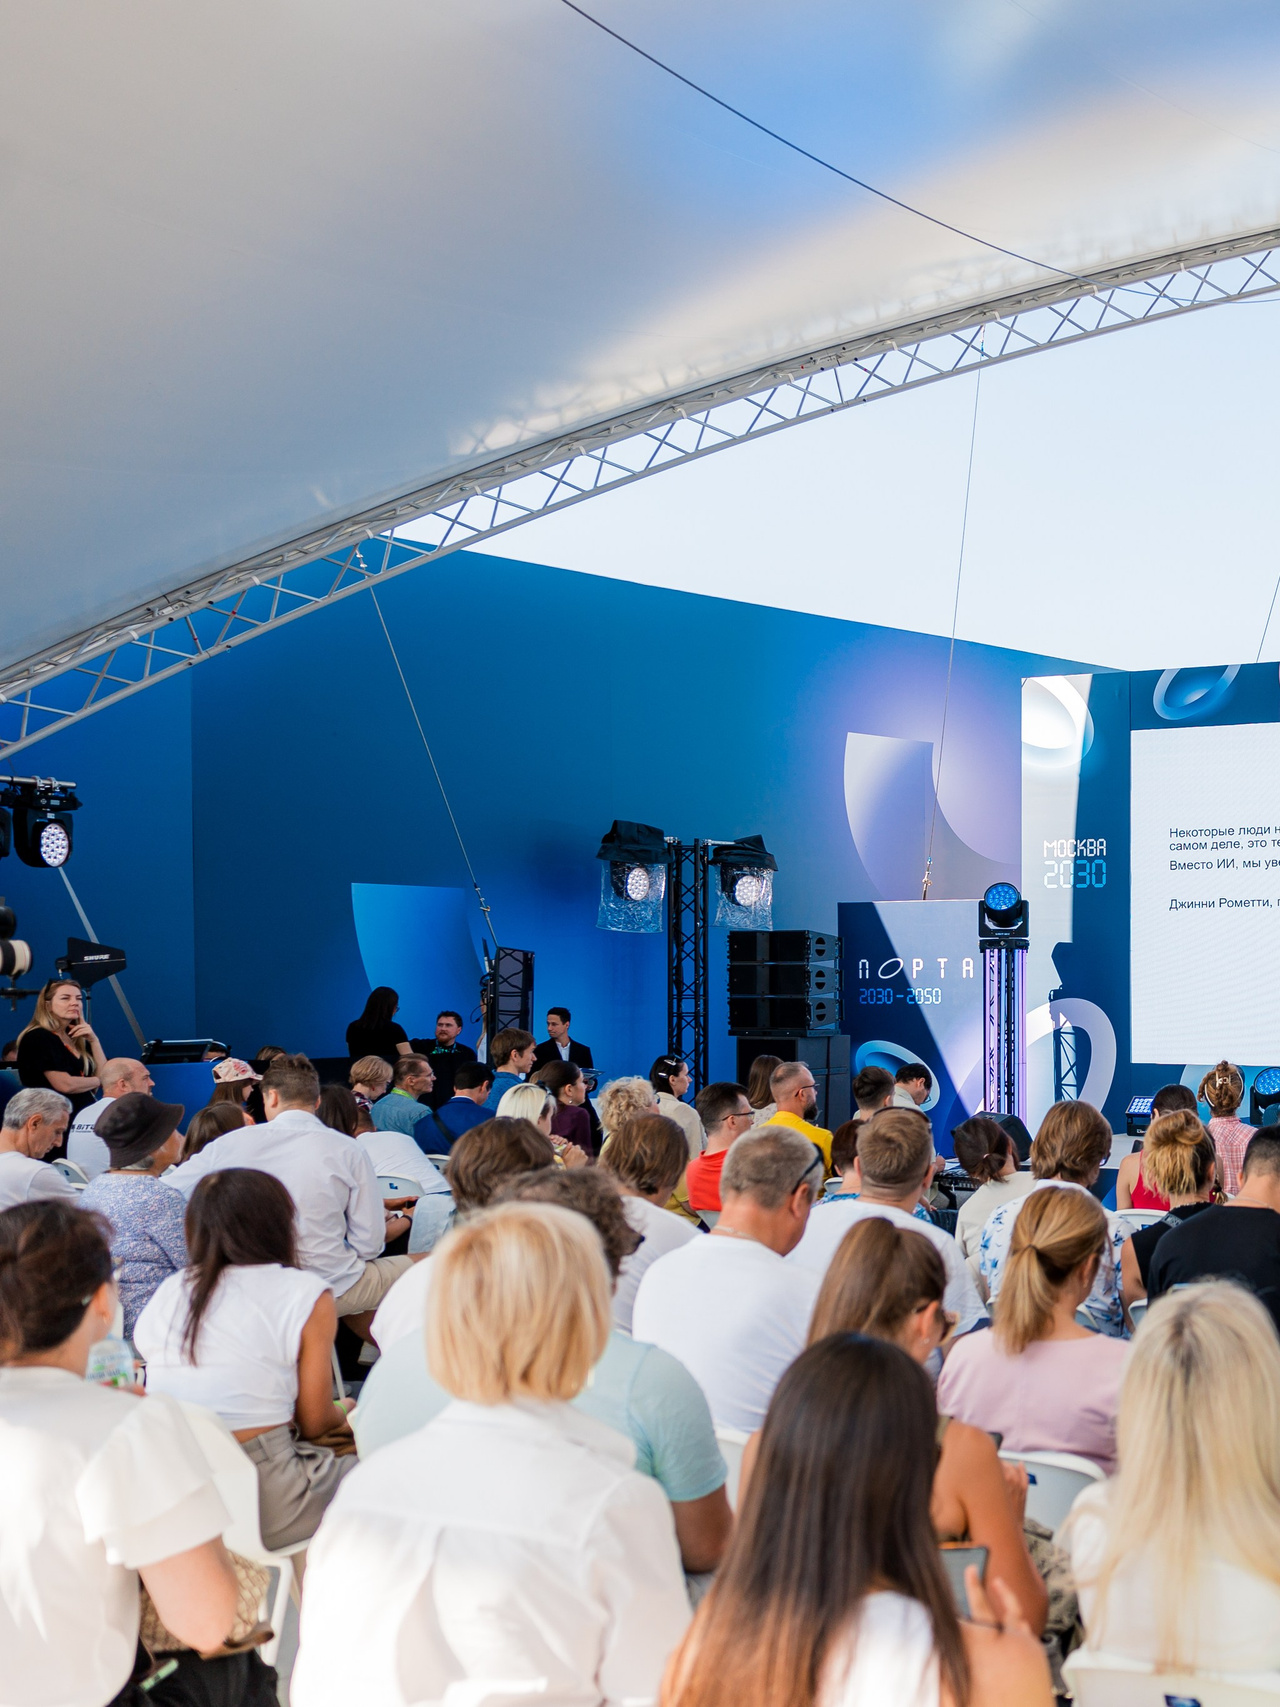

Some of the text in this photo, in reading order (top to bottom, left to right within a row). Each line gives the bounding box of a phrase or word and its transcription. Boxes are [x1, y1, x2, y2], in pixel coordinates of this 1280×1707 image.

[1169, 827, 1235, 839] Некоторые
[1238, 826, 1271, 837] люди
[1043, 838, 1107, 858] МОСКВА
[1169, 841, 1208, 852] самом
[1210, 840, 1244, 852] деле,
[1247, 839, 1268, 849] это
[1169, 860, 1214, 871] Вместо
[1216, 858, 1239, 871] ИИ,
[1242, 860, 1261, 869] мы
[1043, 859, 1107, 889] 2030
[1168, 898, 1216, 912] Джинни
[1218, 897, 1273, 910] Рометти,
[83, 953, 111, 962] SHURE
[858, 957, 975, 980] ПОРТА
